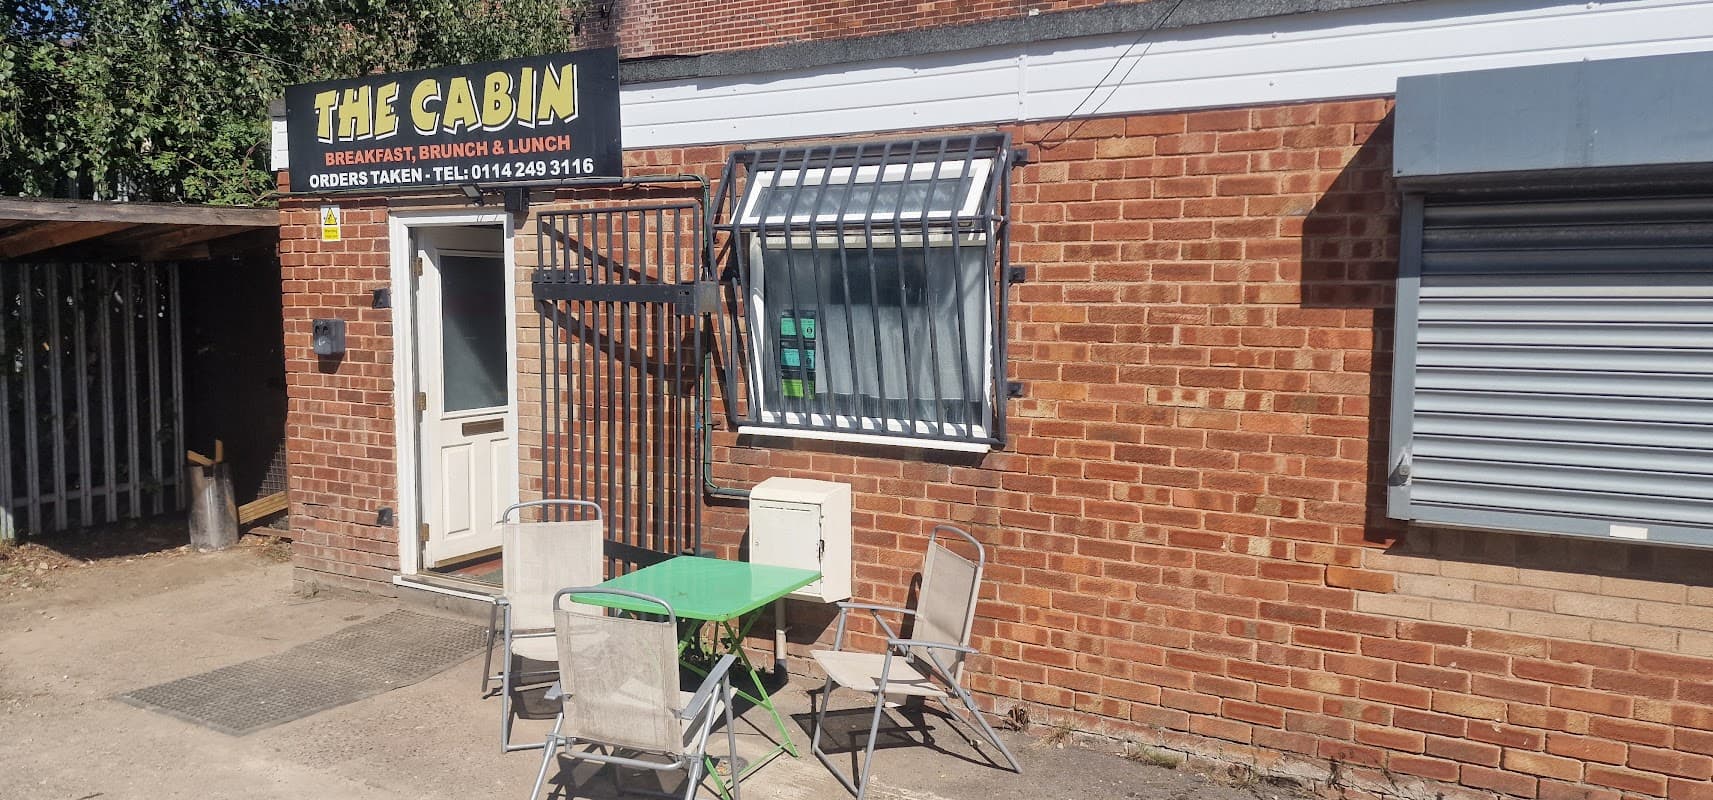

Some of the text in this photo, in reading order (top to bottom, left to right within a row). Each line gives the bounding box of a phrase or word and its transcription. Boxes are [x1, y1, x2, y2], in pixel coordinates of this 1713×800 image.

[315, 62, 578, 144] THE CABIN
[325, 135, 571, 166] BREAKFAST, BRUNCH & LUNCH
[309, 170, 368, 188] ORDERS
[370, 167, 422, 185] TAKEN
[432, 165, 468, 181] TEL:
[471, 162, 512, 180] 0114
[514, 160, 547, 177] 249
[549, 157, 594, 175] 3116
